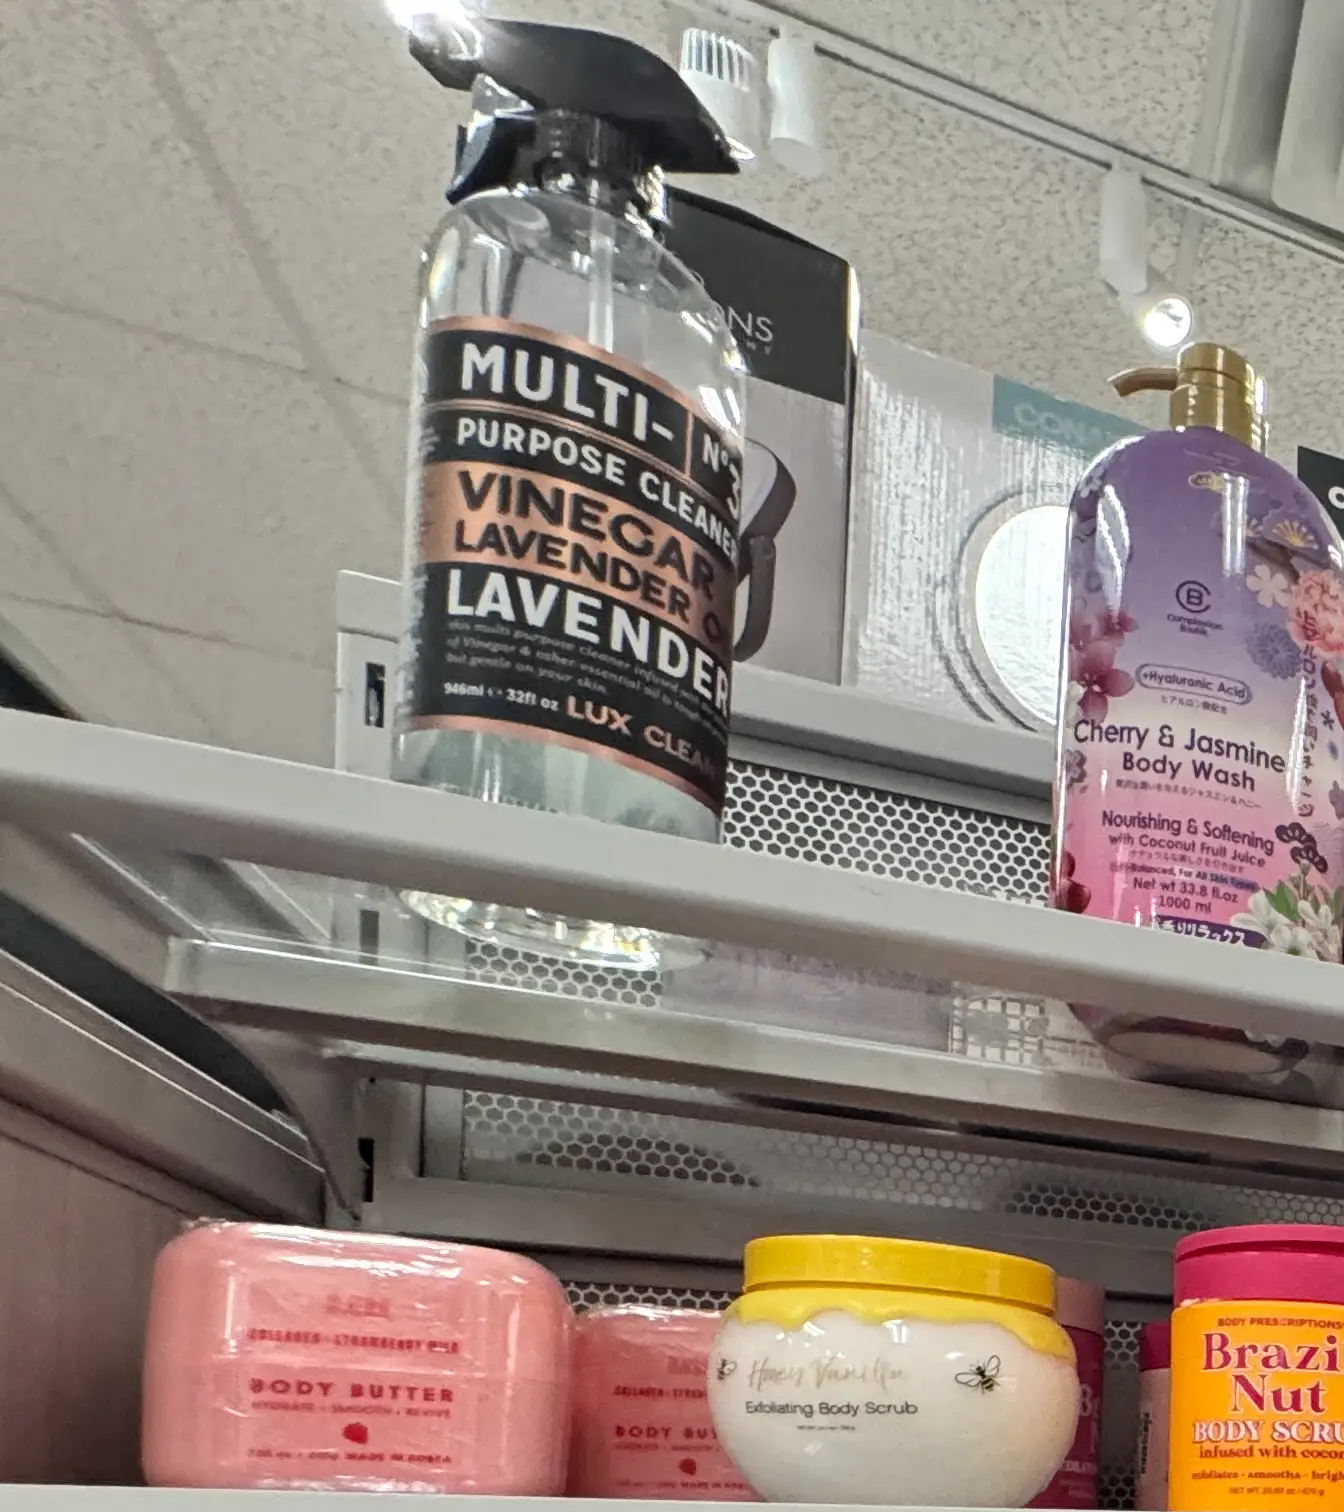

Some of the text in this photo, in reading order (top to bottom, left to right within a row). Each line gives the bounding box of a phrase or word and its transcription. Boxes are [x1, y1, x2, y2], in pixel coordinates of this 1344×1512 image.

[461, 341, 675, 443] MULTI-
[456, 416, 626, 486] PURPOSE
[457, 468, 716, 598] VINEGAR
[453, 519, 692, 627] LAVENDER
[446, 568, 731, 718] LAVENDER
[1217, 681, 1247, 700] Acid
[566, 695, 634, 737] LUX
[1073, 718, 1287, 775] Cherry & Jasmine
[1121, 751, 1257, 793] Body Wash
[1101, 808, 1276, 858] Nourishing & Softening
[1138, 834, 1197, 854] Coconut
[1199, 841, 1228, 859] Fruit
[1229, 849, 1267, 868] Juice
[1132, 875, 1157, 891] Net
[1159, 878, 1177, 893] wt
[1178, 881, 1209, 899] 33.8
[1157, 894, 1213, 914] 1000 ml
[249, 1377, 454, 1404] BODY BUTTER
[744, 1400, 919, 1419] Exfoliating Body Scrub
[1230, 1374, 1328, 1414] Nut
[1191, 1419, 1266, 1444] BODY
[1198, 1444, 1255, 1460] infused
[1257, 1444, 1299, 1460] with
